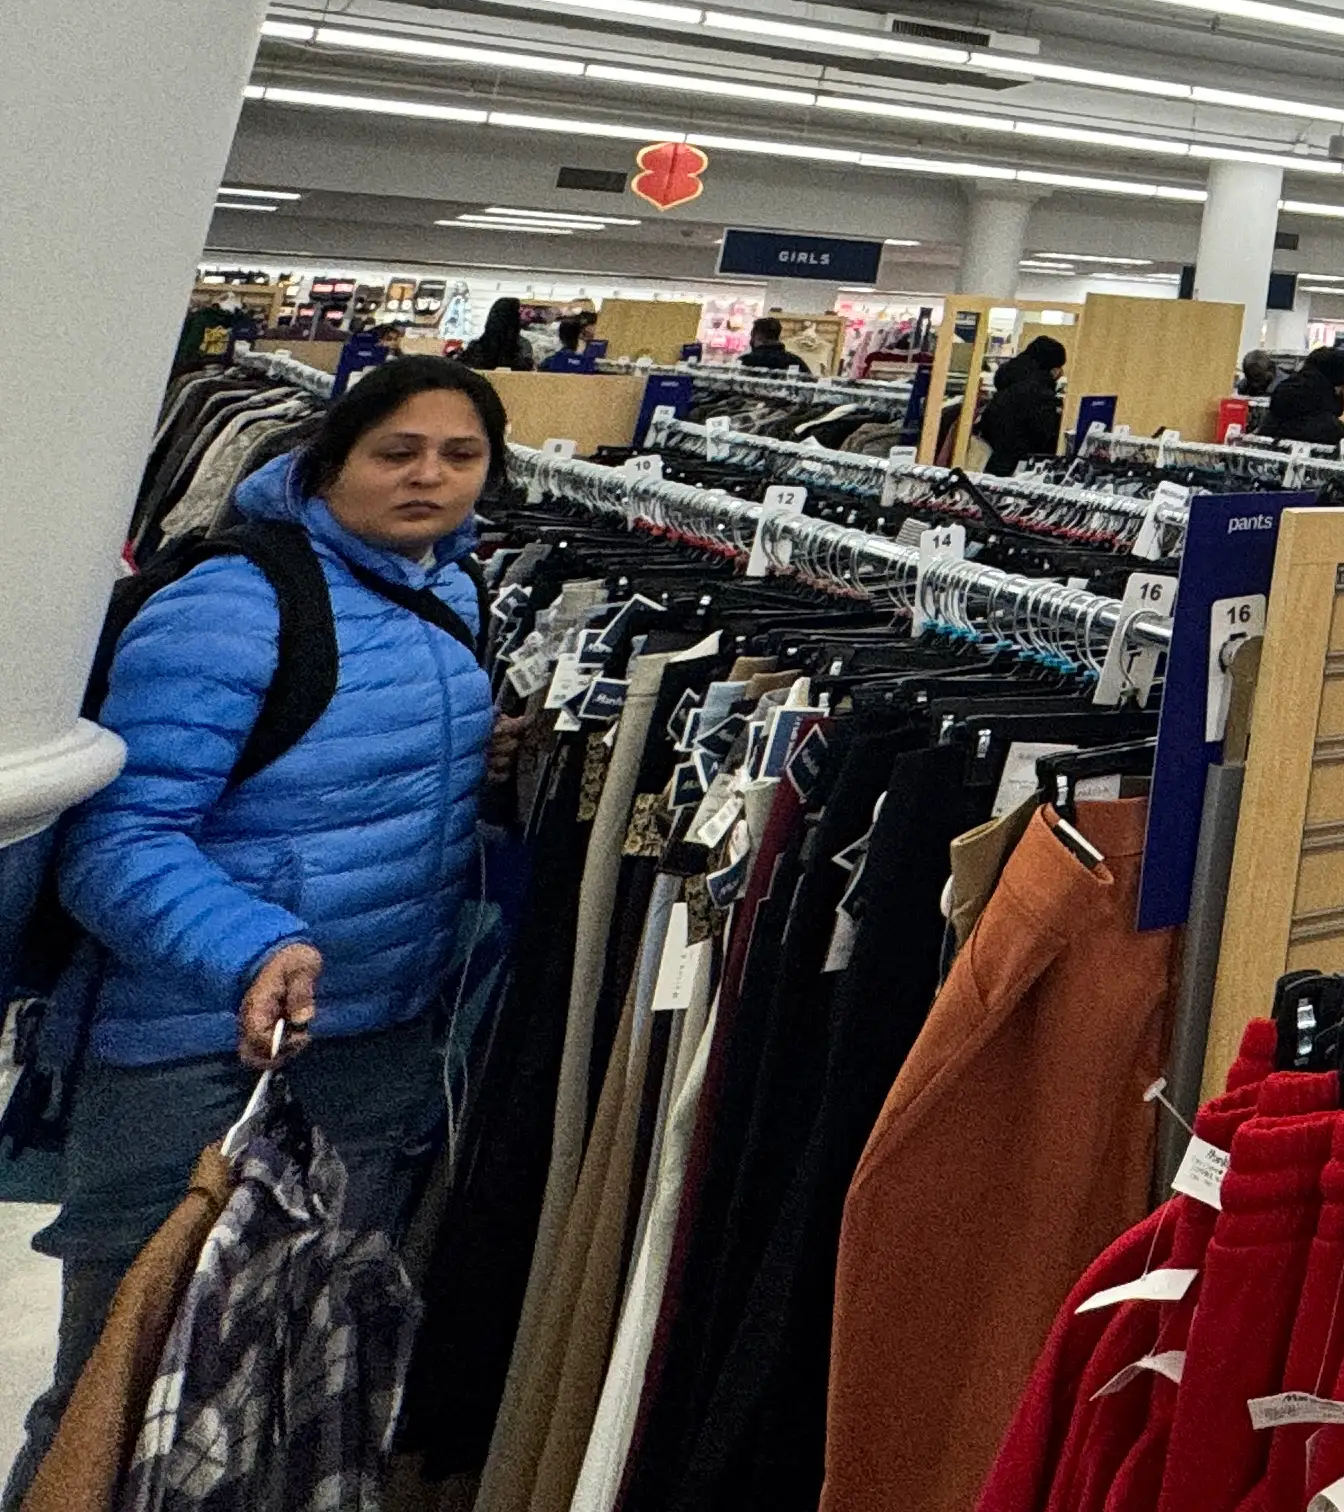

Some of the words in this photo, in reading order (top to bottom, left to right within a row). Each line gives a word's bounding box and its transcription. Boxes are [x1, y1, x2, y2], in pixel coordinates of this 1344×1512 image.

[778, 249, 831, 266] GIRLS
[635, 460, 651, 472] 10
[777, 493, 795, 505] 12
[1227, 513, 1273, 535] pants
[932, 533, 952, 548] 14
[1139, 582, 1162, 601] 16
[1226, 604, 1251, 626] 16
